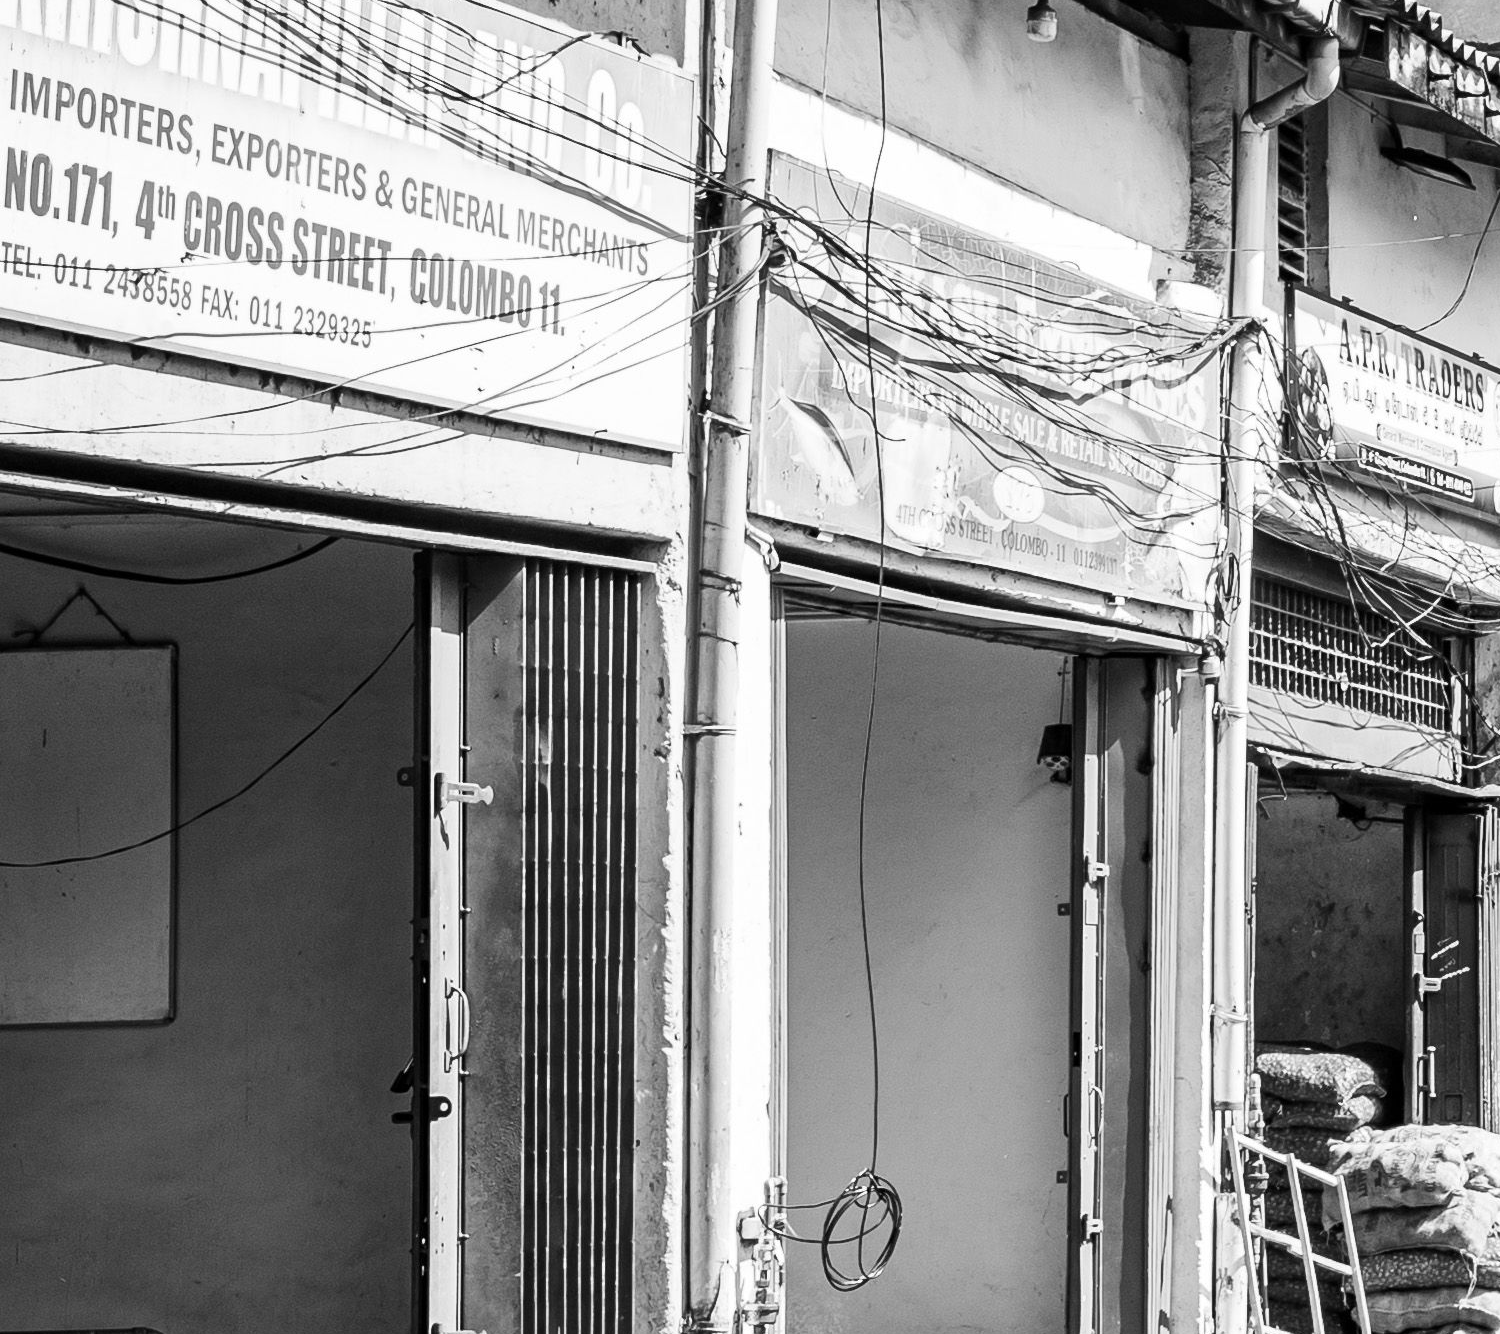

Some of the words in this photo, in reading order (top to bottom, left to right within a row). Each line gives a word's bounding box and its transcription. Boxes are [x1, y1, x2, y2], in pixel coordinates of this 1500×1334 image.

[463, 29, 566, 169] AND
[10, 69, 200, 166] IMPORTERS,
[212, 123, 366, 200] EXPORTERS
[375, 171, 393, 208] &
[402, 177, 509, 239] GENERAL
[517, 209, 649, 275] MERCHANTS
[1, 241, 41, 279] TEL:
[54, 253, 92, 290] 011
[104, 264, 191, 309] 2438558
[201, 285, 238, 321] FAX:
[249, 296, 282, 330] 011
[293, 306, 372, 348] 2329325
[5, 147, 118, 238] NO.171,
[136, 180, 176, 240] 4th
[184, 191, 284, 270] CROSS
[291, 218, 395, 302] STREET,
[410, 248, 531, 328] COLOMBO
[539, 282, 565, 335] 11.
[960, 393, 1009, 437] WHOLE
[1014, 409, 1045, 444] SALE
[1060, 428, 1105, 468] RETAIL
[1401, 343, 1484, 412] TRADERS
[1001, 529, 1048, 558] COLOMBO
[1056, 544, 1066, 563] 11
